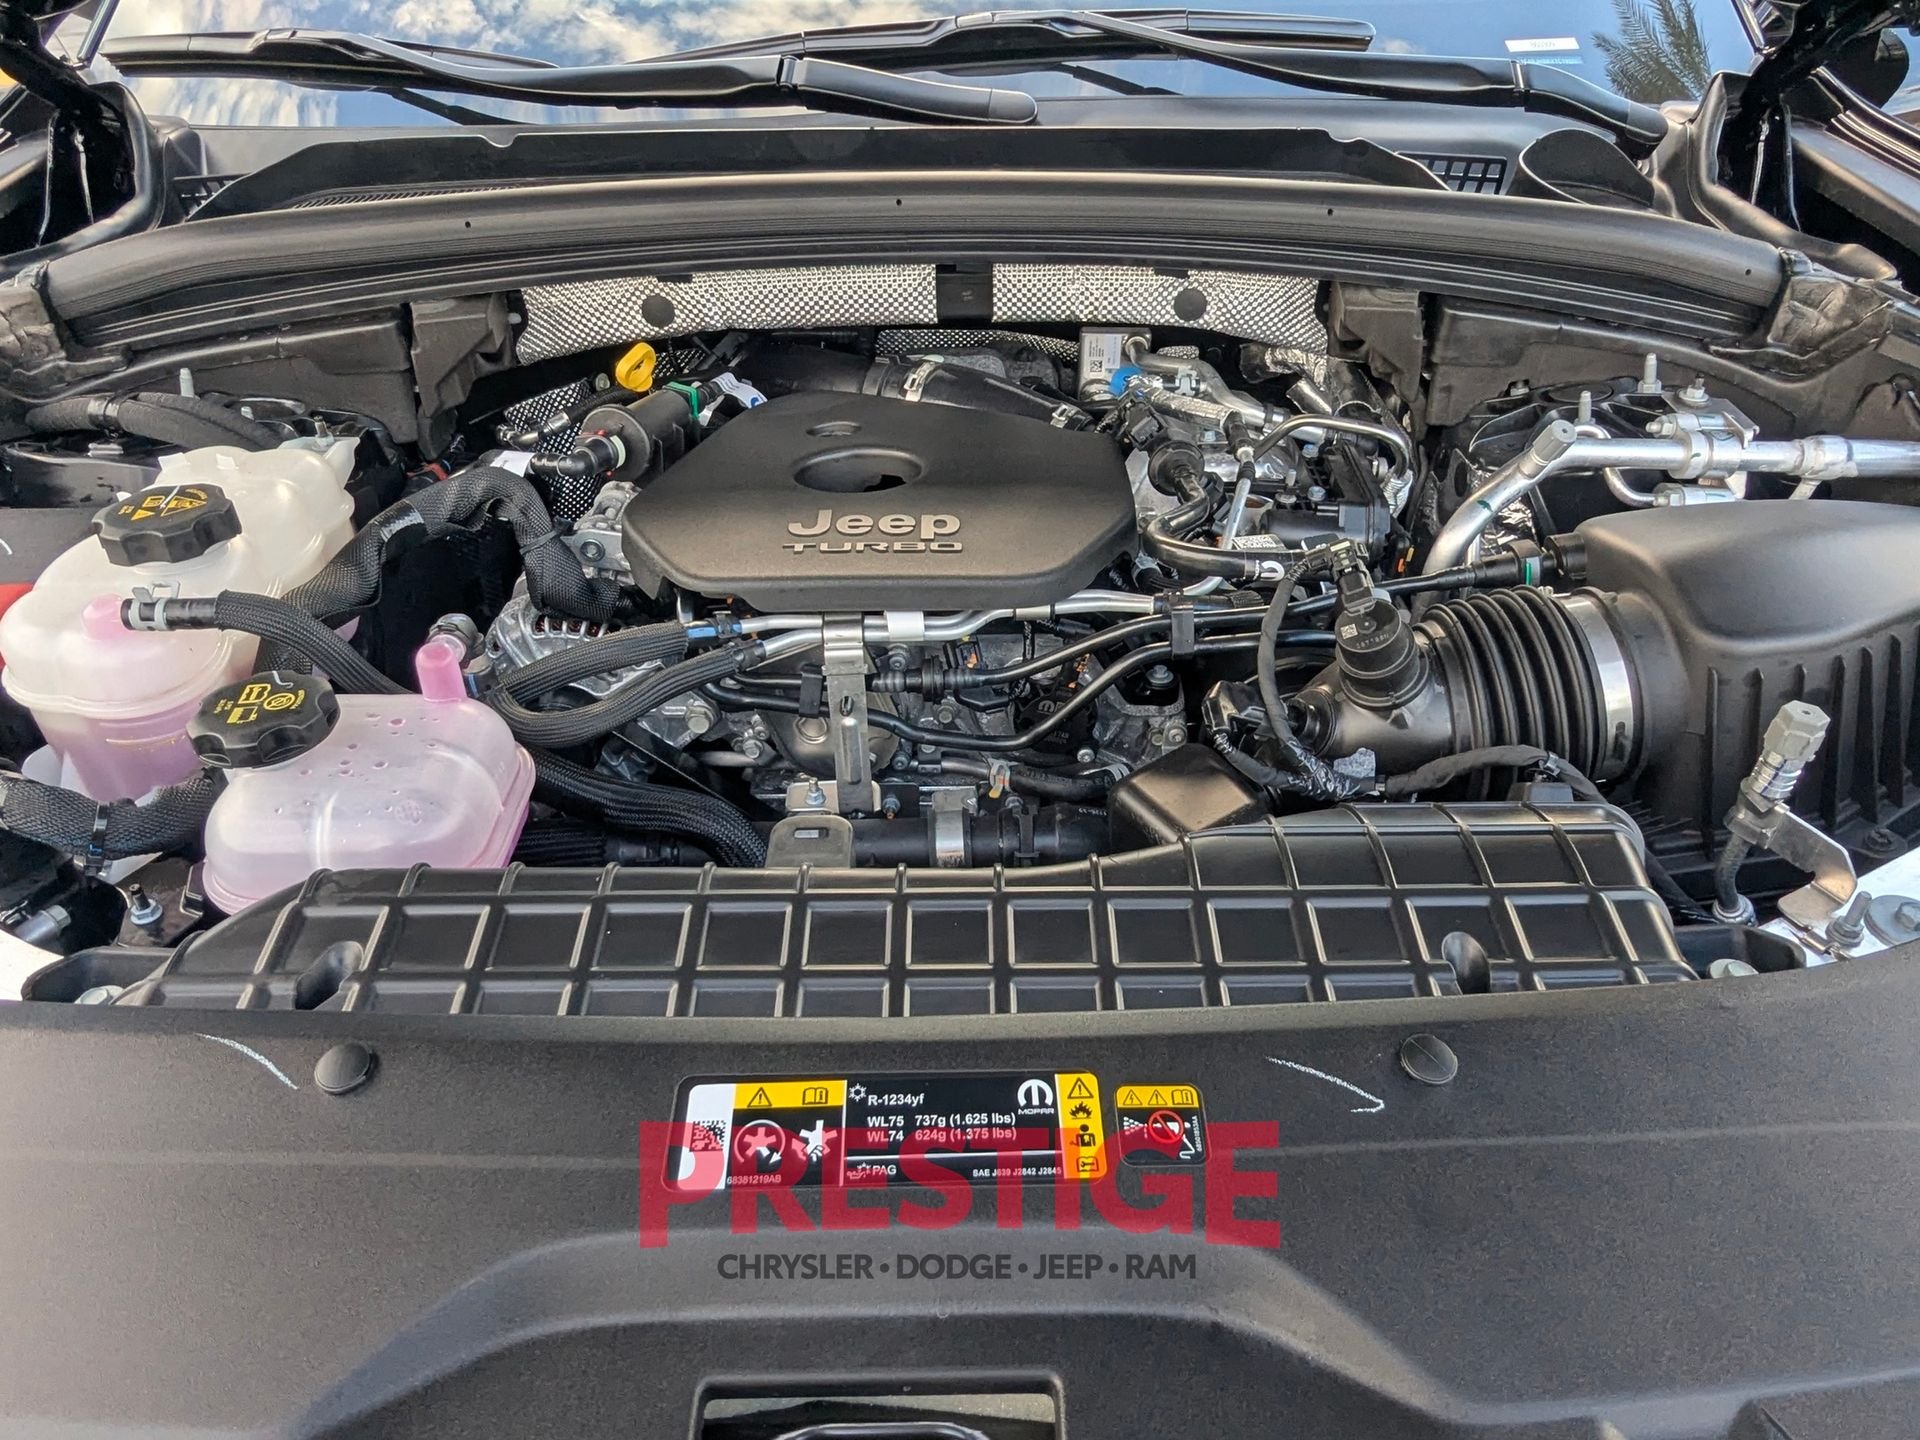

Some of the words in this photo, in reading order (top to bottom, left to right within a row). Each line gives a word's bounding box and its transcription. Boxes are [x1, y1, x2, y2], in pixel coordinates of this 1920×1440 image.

[787, 509, 961, 540] Jeep
[782, 542, 963, 554] TURBO
[867, 1093, 925, 1107] R-1234yf
[1017, 1107, 1055, 1115] MOPAR
[867, 1115, 905, 1127] WL75
[915, 1114, 946, 1128] 737g
[949, 1113, 989, 1128] (1.625
[991, 1112, 1016, 1126] lbs)
[867, 1129, 905, 1142] WL74
[915, 1129, 947, 1142] 624g
[949, 1128, 990, 1142] (1.375
[992, 1127, 1018, 1140] lbs)
[872, 1164, 897, 1176] PAG
[972, 1168, 991, 1177] SAE
[1012, 1167, 1036, 1176] J2842
